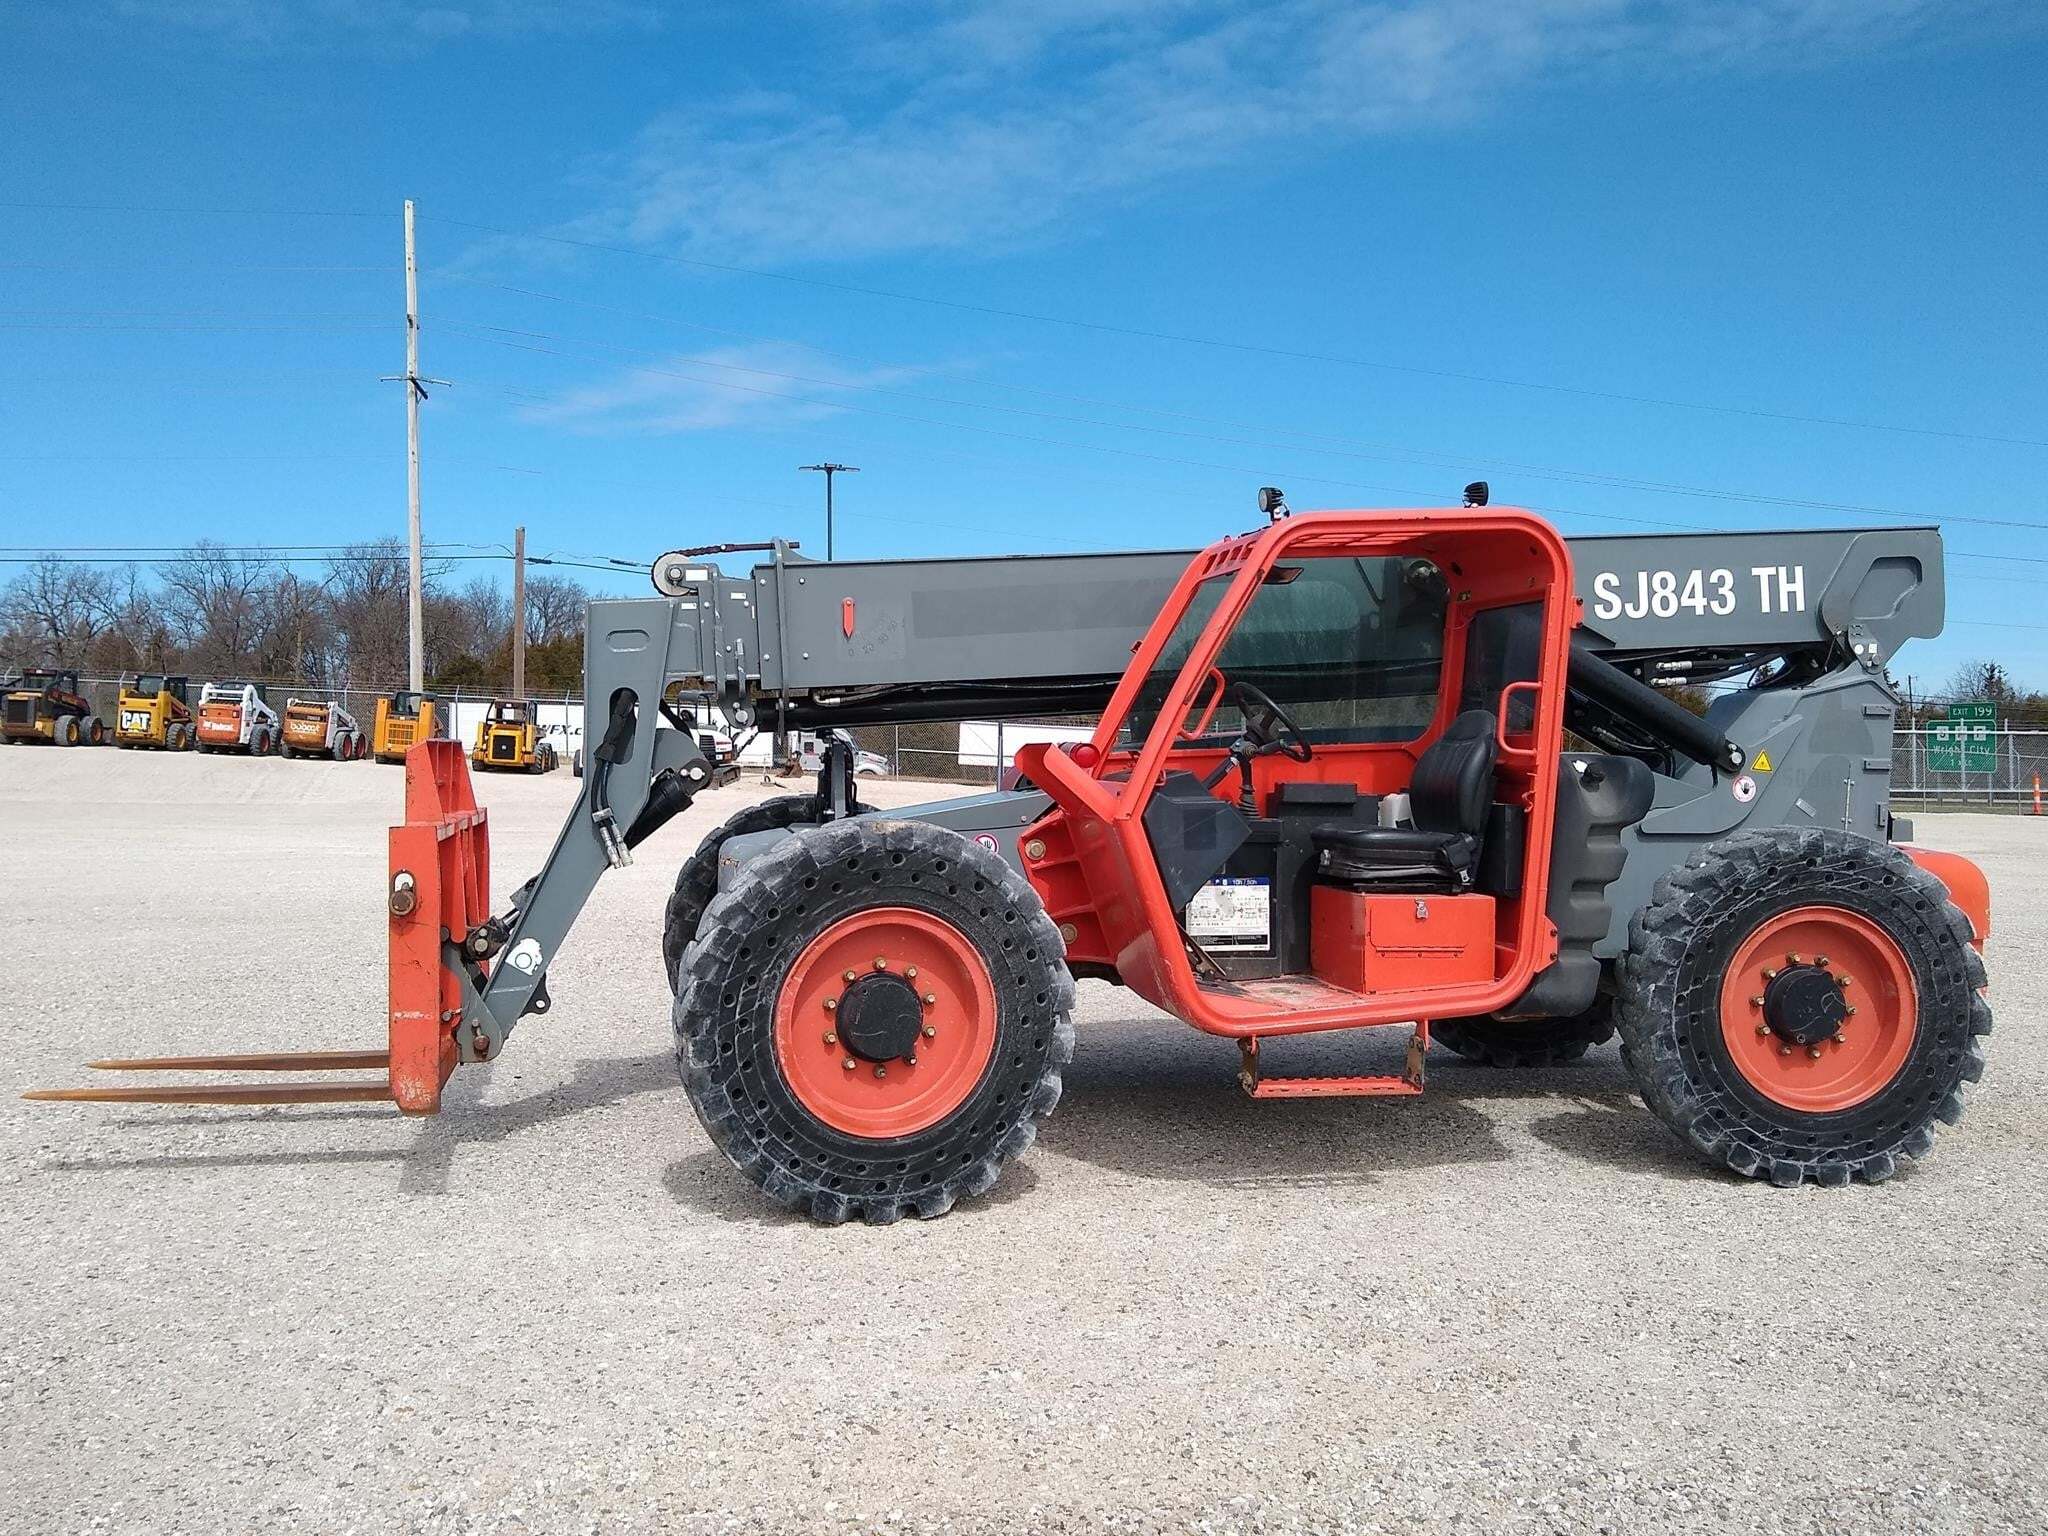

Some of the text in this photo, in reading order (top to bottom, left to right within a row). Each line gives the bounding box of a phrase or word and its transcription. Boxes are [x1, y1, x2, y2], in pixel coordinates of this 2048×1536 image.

[1593, 565, 1806, 620] SJ843 TH
[1952, 706, 1993, 717] EXIT 199
[121, 711, 151, 730] CAT
[1933, 745, 1990, 757] Wrigh City
